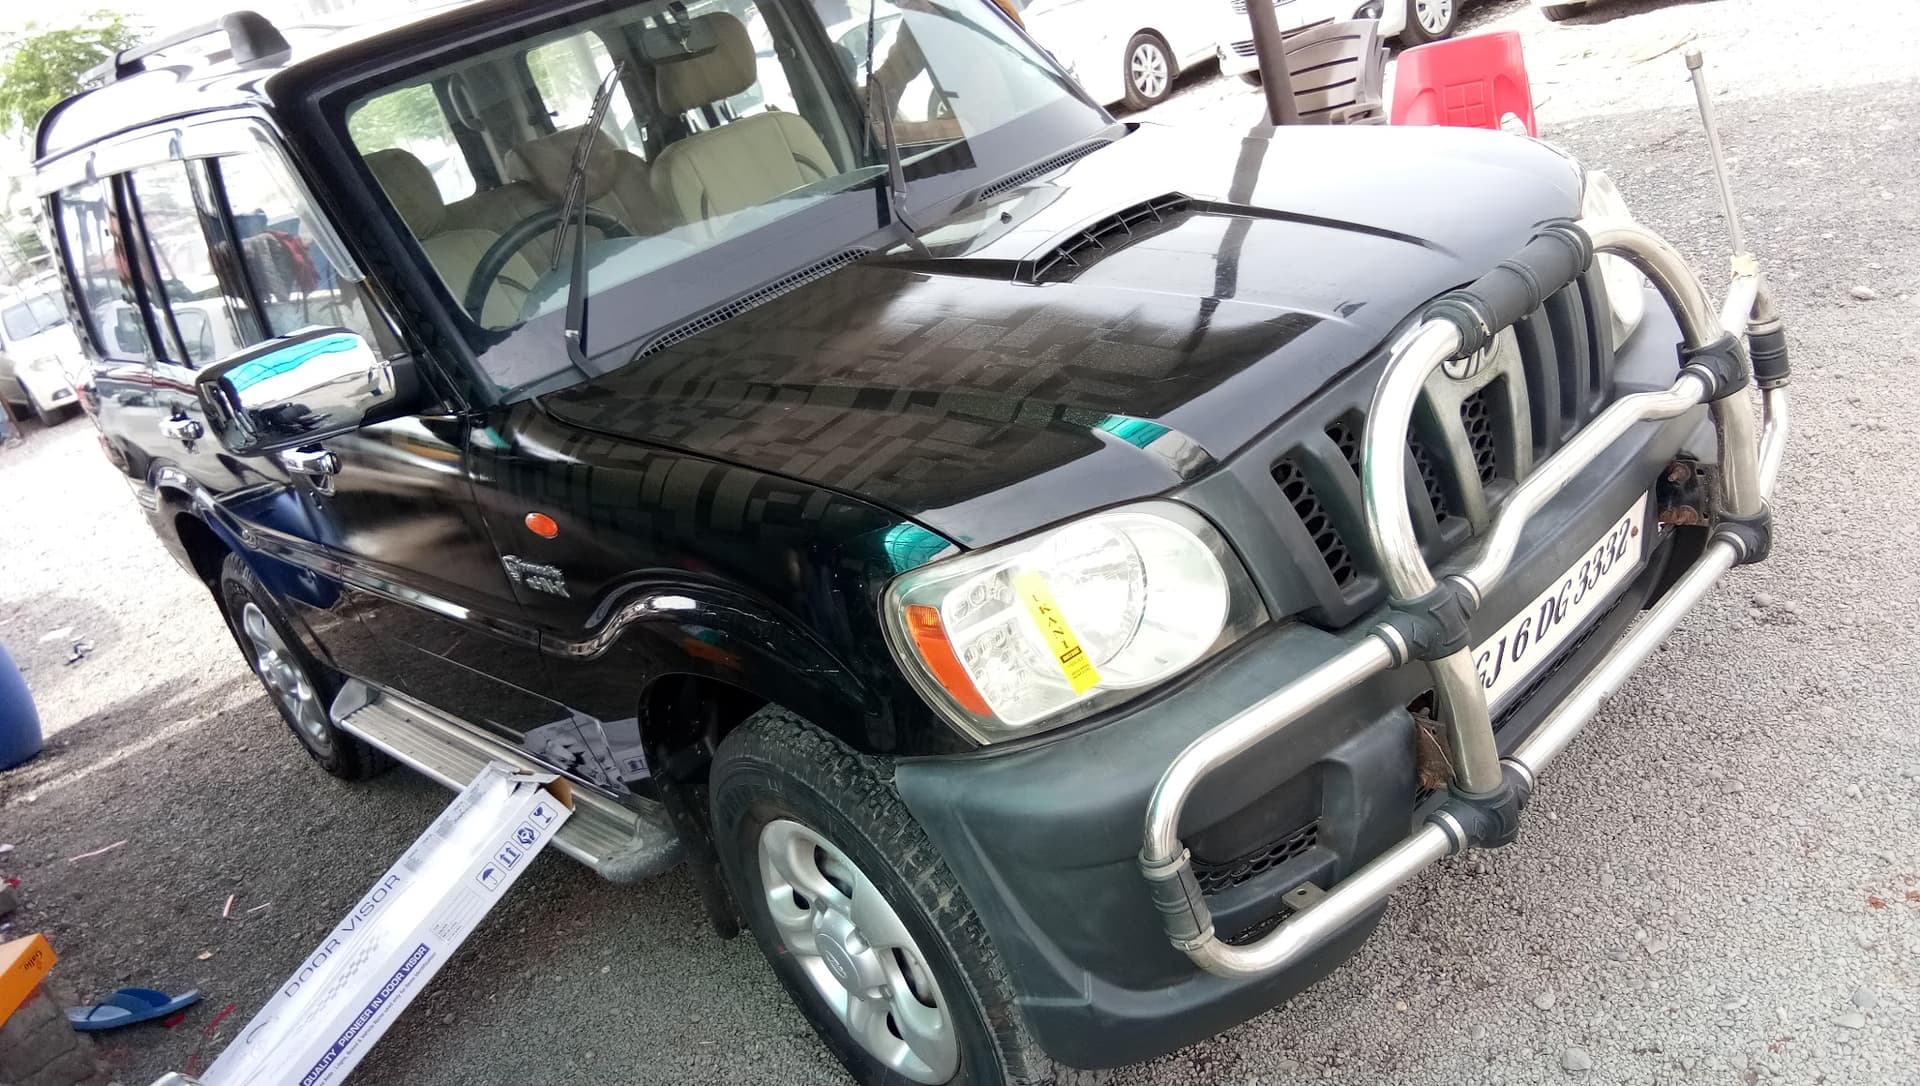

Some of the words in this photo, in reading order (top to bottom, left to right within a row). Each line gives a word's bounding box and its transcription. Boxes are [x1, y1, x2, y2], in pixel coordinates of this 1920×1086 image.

[1511, 617, 1532, 663] 6
[1535, 579, 1572, 644] DG
[1574, 517, 1631, 605] 3332
[284, 938, 342, 998] DOOR
[341, 873, 401, 932] VISOR
[303, 1047, 338, 1086] QUALITY
[338, 1008, 373, 1045] PIONEER
[372, 995, 385, 1011] IN
[381, 971, 405, 999] DOOR
[402, 945, 429, 974] VISOR
